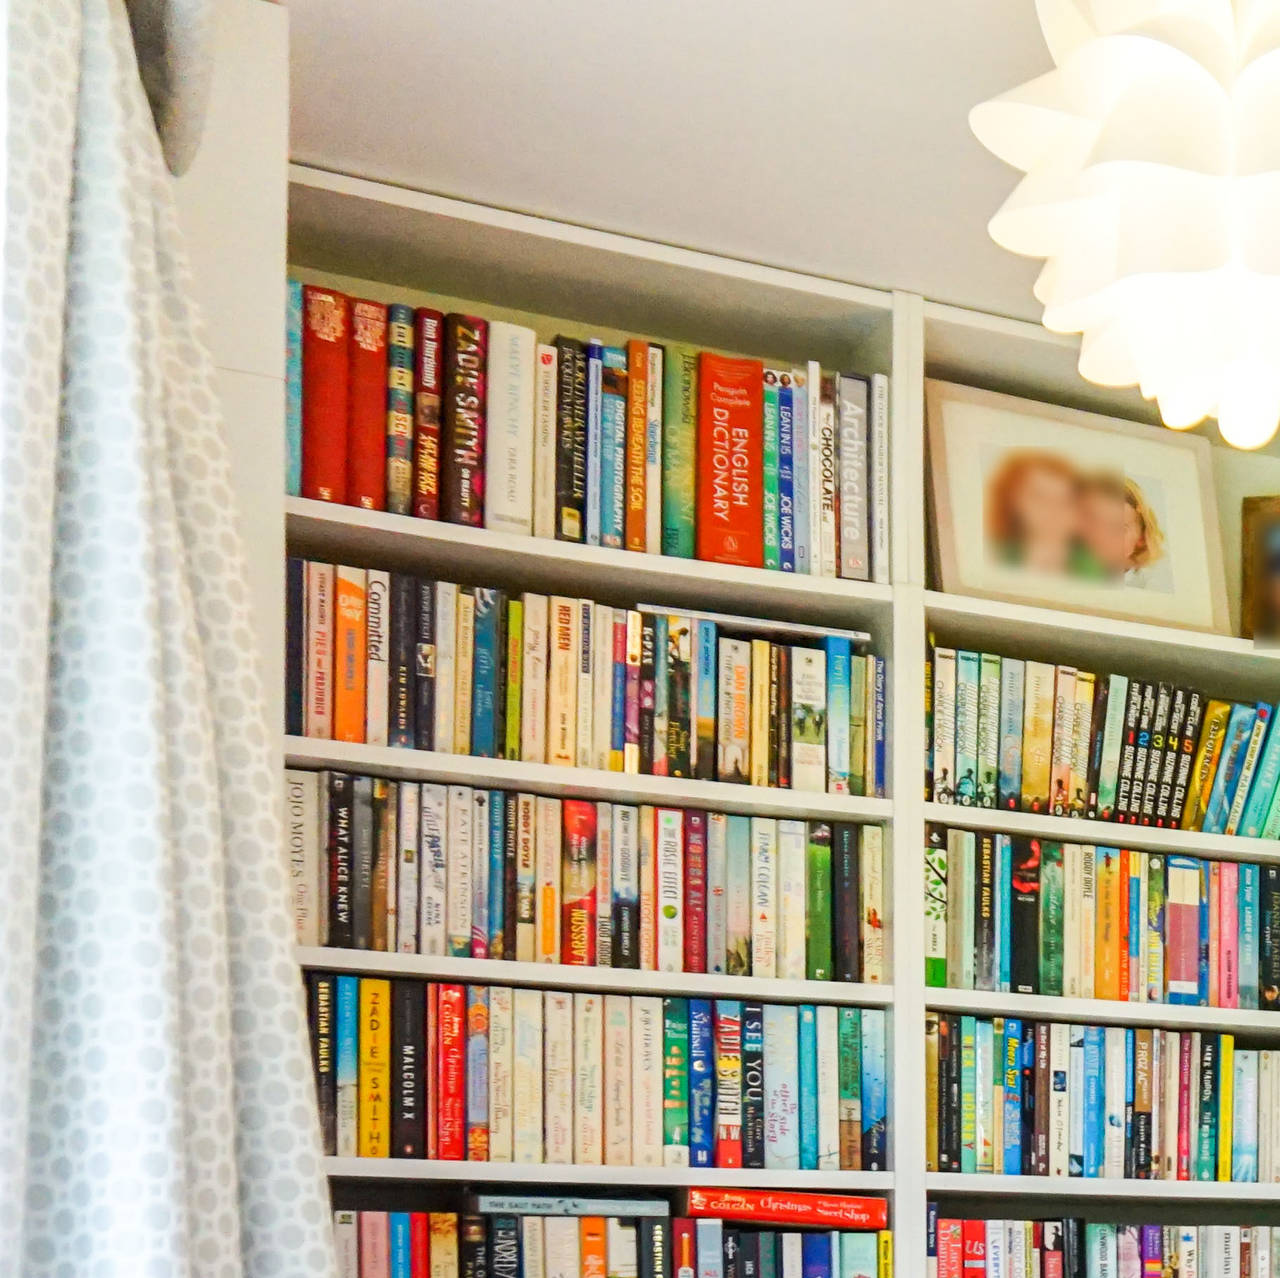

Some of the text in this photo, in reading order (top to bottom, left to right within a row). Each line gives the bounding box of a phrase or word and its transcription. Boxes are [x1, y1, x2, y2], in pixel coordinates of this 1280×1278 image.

[421, 341, 439, 389] Burgundy
[453, 326, 482, 466] ZADIE SMITH
[630, 378, 646, 415] SEEING
[779, 405, 792, 432] LEAN
[630, 416, 645, 465] BENEATH
[712, 407, 732, 522] DICTIONARY
[611, 399, 626, 531] DIGITAL PHOTOGRAPHY
[629, 466, 644, 485] THE
[731, 426, 750, 507] ENGLISH
[764, 401, 777, 547] LEAN JOE WICKS
[821, 426, 834, 513] CHOCOLATE
[842, 399, 866, 541] Architecture
[780, 493, 792, 513] JOE
[780, 515, 792, 550] WICKS
[368, 580, 387, 662] Committed
[558, 604, 572, 651] RED MEN
[399, 665, 408, 684] KIM
[876, 660, 884, 672] The
[399, 687, 408, 730] EDWARDS
[733, 694, 747, 739] BROWN
[1117, 745, 1135, 812] SUZANNE COLLINS
[1130, 731, 1150, 814] 2 SUZANNE COLLINS
[1143, 734, 1164, 815] 3 SUZANNE COLLINS
[1156, 735, 1179, 817] 4 SUZANNE COLLINS
[1170, 739, 1194, 819] 5 SUZANNE COLLINS
[337, 807, 349, 923] WHAT ALICE KNEW
[663, 871, 678, 900] EFFECT
[980, 837, 993, 918] SEBASTIAN FAULKS
[1082, 851, 1095, 875] RODDY
[570, 908, 588, 967] LARSSON
[317, 981, 331, 1074] SEBASTIAN FAULKS
[442, 1003, 453, 1046] COLGAN
[691, 1011, 706, 1058] Mansell
[402, 1045, 416, 1121] MALCOLM X
[719, 1013, 741, 1117] ZADIE SMITH
[746, 1020, 764, 1102] SEE YOU
[1006, 1037, 1020, 1088] Meera Syal
[1137, 1041, 1149, 1084] PROZAC
[766, 1112, 781, 1143] story
[779, 1115, 790, 1136] side
[711, 1200, 756, 1211] COLGAN
[476, 1245, 487, 1267] THE
[651, 1224, 665, 1272] SEBASTIAN
[949, 1243, 963, 1270] Lucy
[1222, 1232, 1234, 1274] marian
